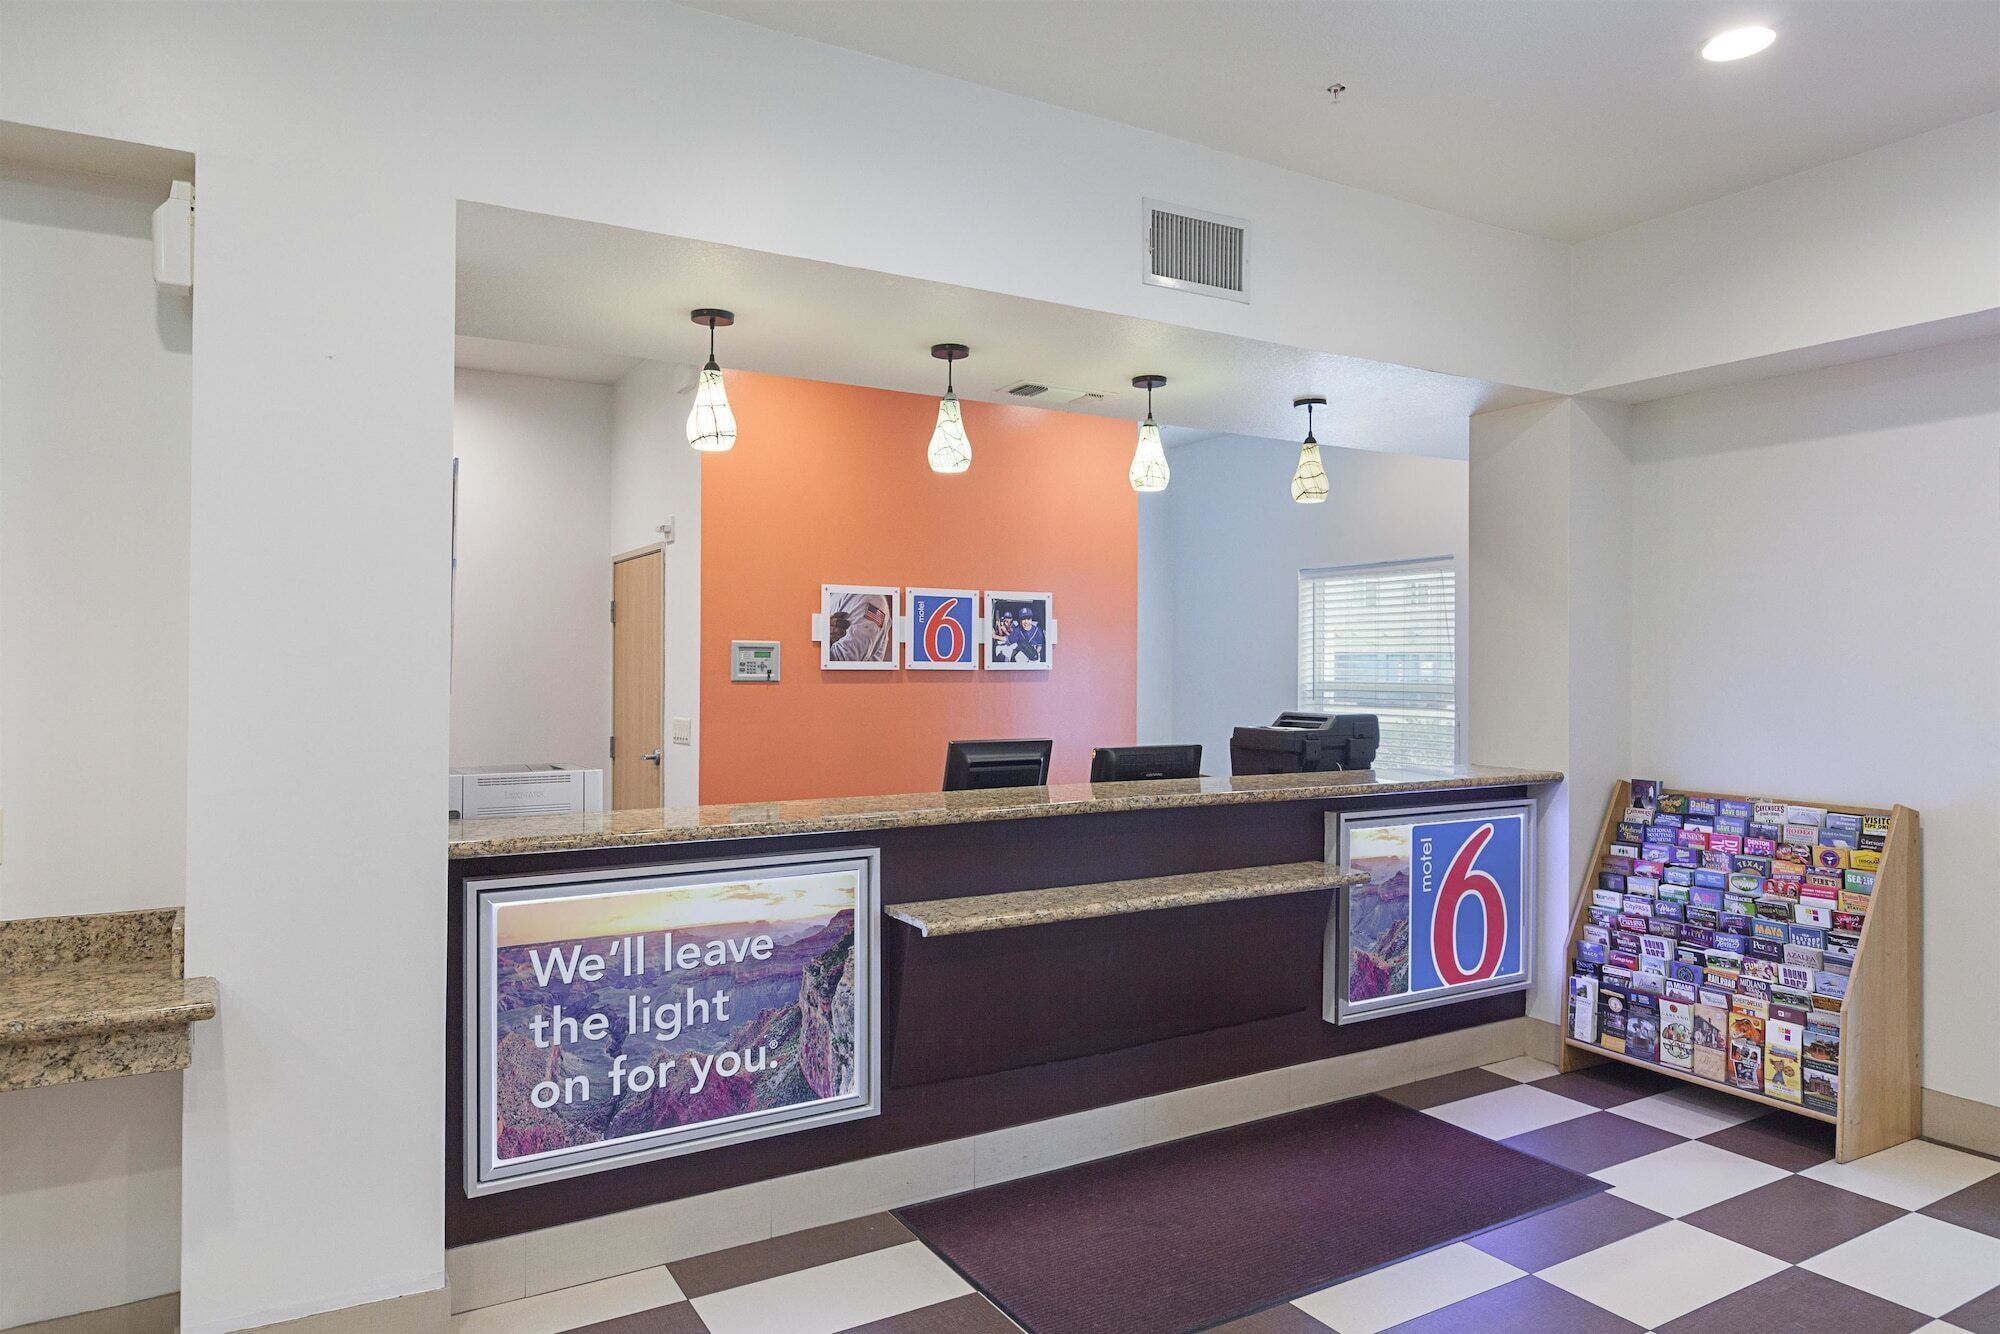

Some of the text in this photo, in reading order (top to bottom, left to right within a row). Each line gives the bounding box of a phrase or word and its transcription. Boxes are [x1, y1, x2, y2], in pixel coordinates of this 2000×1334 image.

[917, 600, 925, 623] motel
[923, 597, 966, 663] 6
[1690, 800, 1715, 810] Dallas
[1786, 828, 1814, 836] RODEO
[1420, 837, 1433, 893] motel
[1737, 860, 1764, 871] TEXAS
[1847, 874, 1862, 884] SEA
[1430, 822, 1508, 986] 6
[1755, 924, 1784, 938] MAYA
[1643, 939, 1665, 951] ROUND
[528, 932, 774, 988] We'll leave
[1786, 951, 1816, 963] AZALEA
[1707, 973, 1736, 989] RAILROAD
[1782, 967, 1808, 982] ROUND
[1740, 978, 1767, 991] MIDLAND
[529, 988, 731, 1050] the light
[530, 1074, 590, 1110] on
[607, 1054, 676, 1097] for
